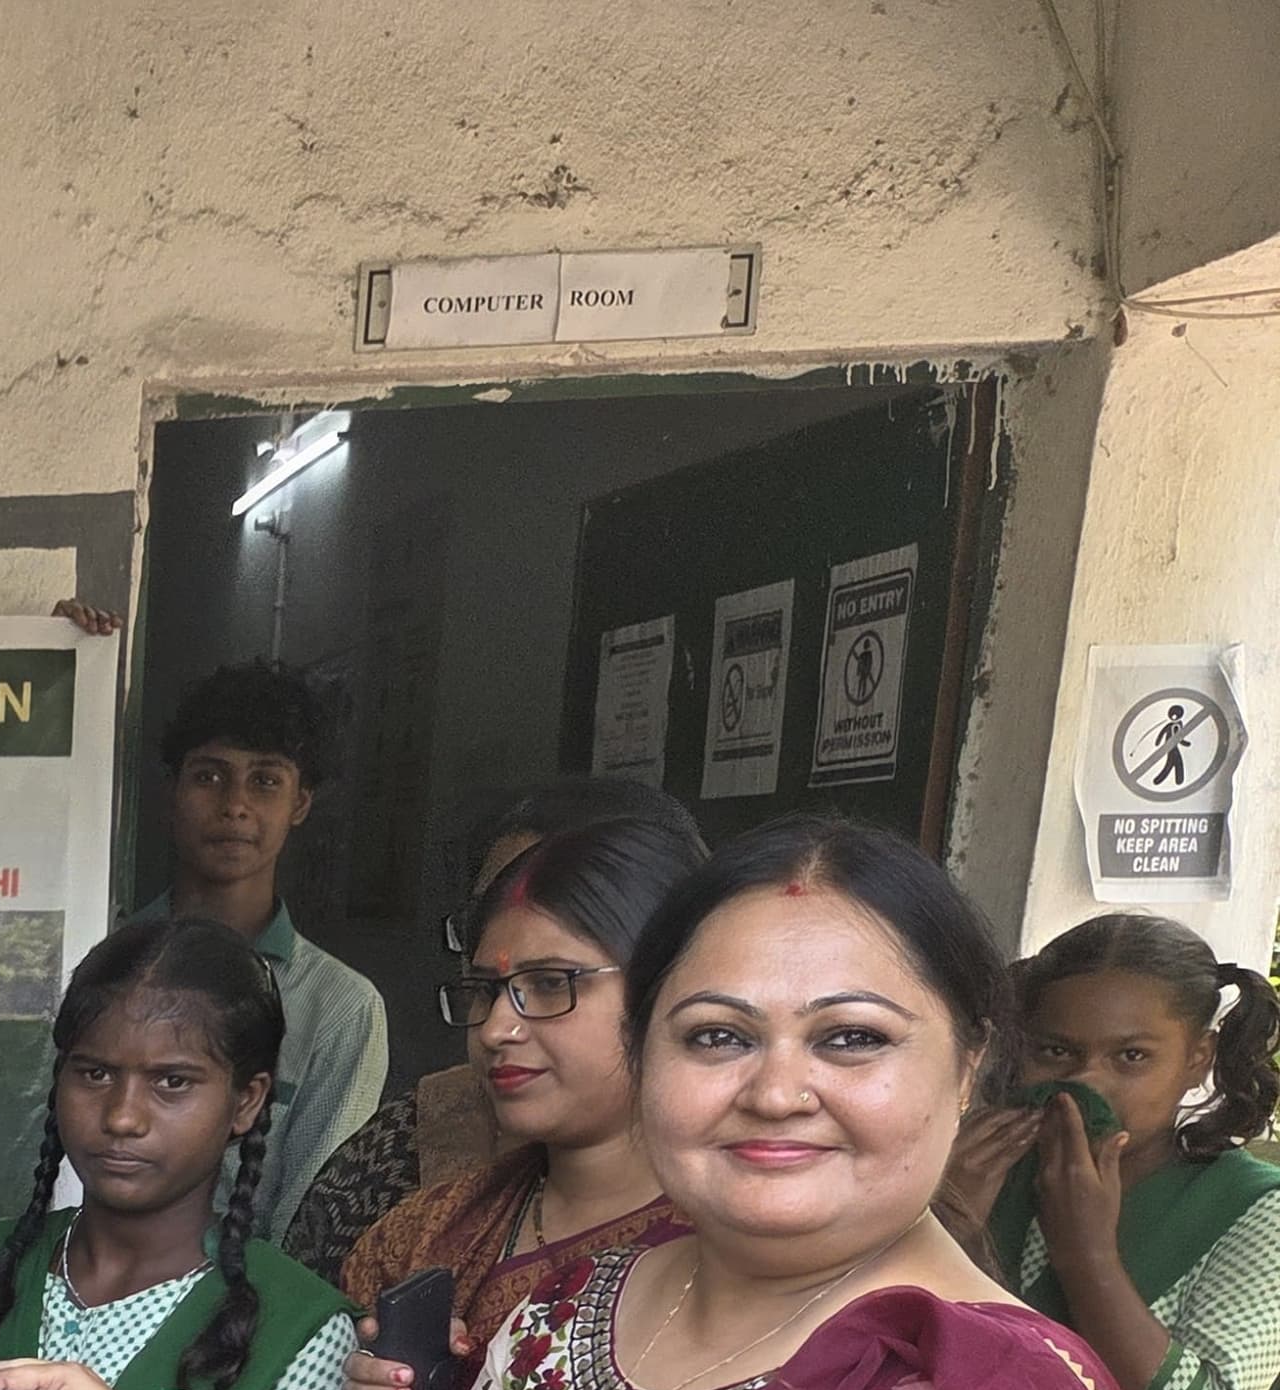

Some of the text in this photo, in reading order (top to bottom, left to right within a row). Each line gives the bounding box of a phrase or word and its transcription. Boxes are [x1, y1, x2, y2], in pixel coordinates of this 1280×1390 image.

[423, 288, 636, 314] COMPUTER ROOM
[836, 587, 905, 622] NO ENTRY
[833, 713, 884, 734] WITHOUT
[822, 730, 891, 753] PERMISSION
[1114, 817, 1209, 835] NO SPITTING
[1116, 836, 1198, 854] KEEP AREA
[1133, 856, 1180, 873] CLEAN
